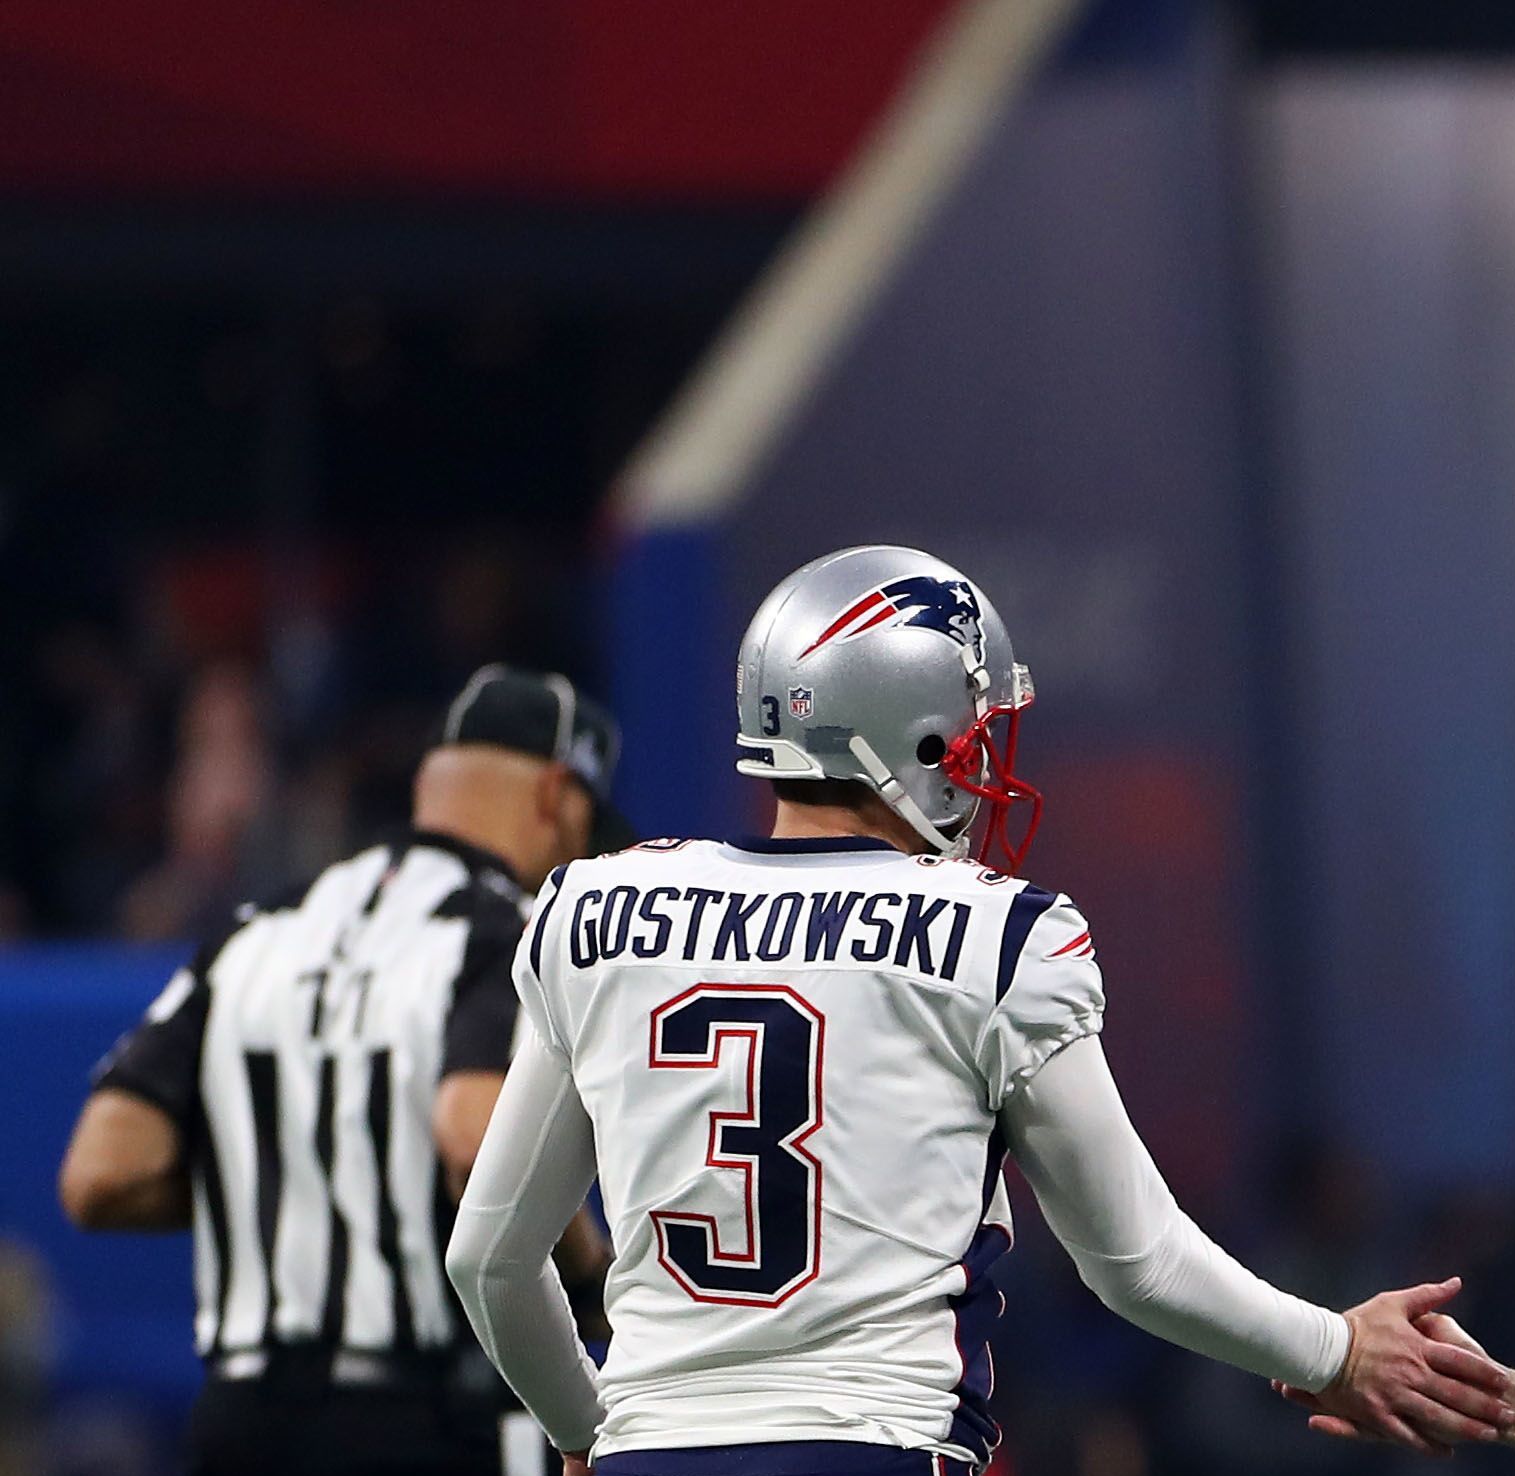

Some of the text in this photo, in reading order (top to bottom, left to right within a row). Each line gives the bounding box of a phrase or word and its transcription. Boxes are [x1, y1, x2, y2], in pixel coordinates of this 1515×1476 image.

[761, 695, 781, 737] 3
[570, 885, 972, 982] GOSTKOWSKI
[649, 981, 827, 1309] 3
